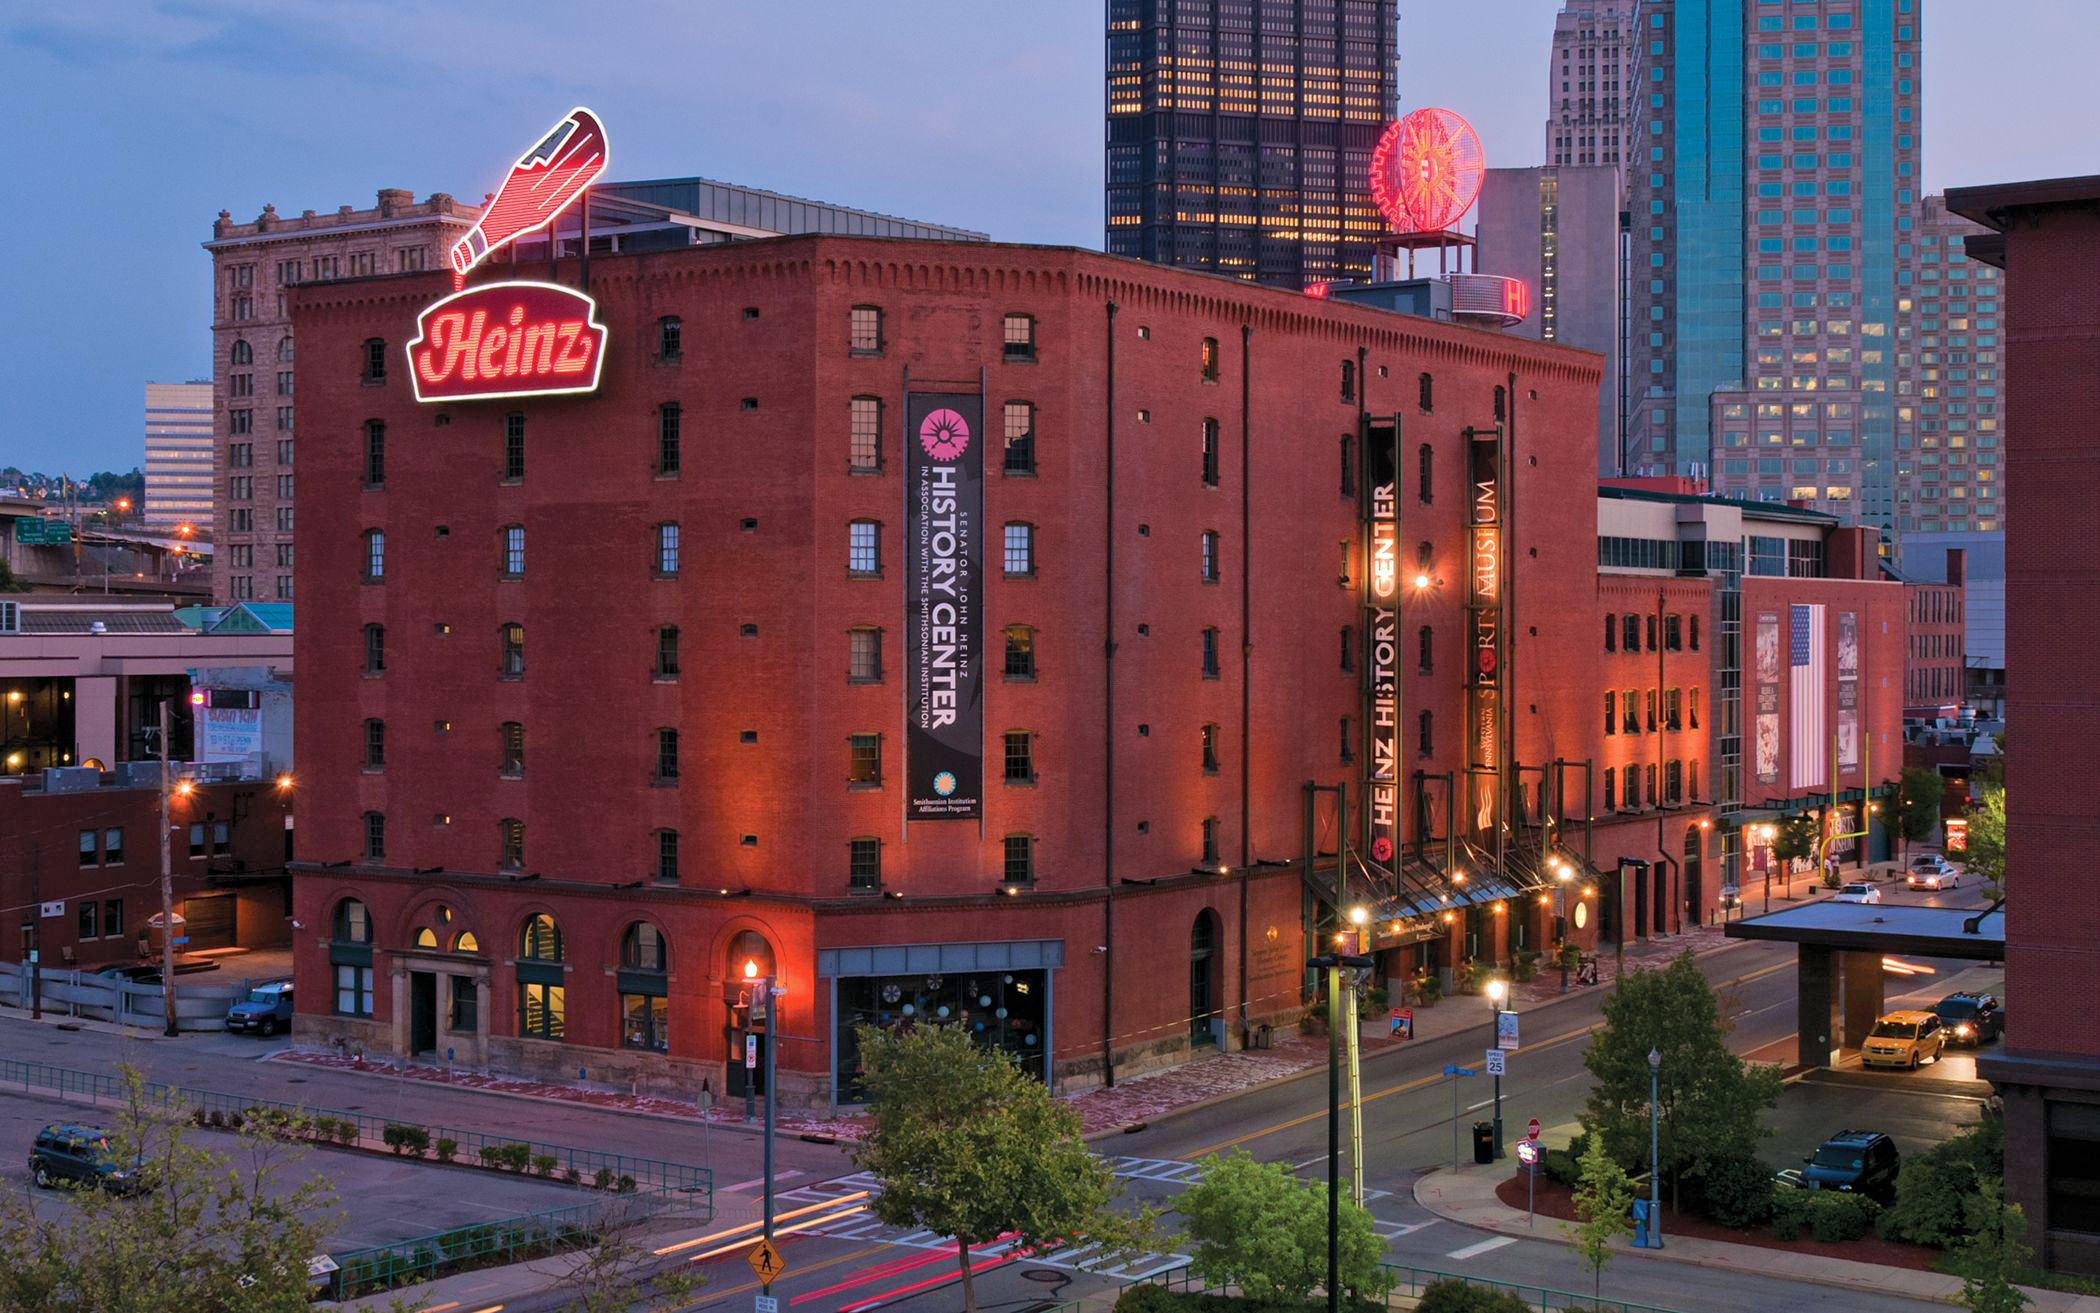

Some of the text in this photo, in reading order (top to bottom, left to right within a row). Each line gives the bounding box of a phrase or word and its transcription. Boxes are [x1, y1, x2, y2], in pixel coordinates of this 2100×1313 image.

[420, 307, 594, 384] Heinz
[920, 466, 929, 729] IN ASSOCIATION WITH THE SMITHSONIAN INSTITUTION
[960, 512, 968, 678] SENATOR JOHN HEINZ
[1374, 481, 1395, 598] CENTER
[1476, 478, 1496, 597] MUSEUM
[932, 467, 956, 730] HISTORY CENTER
[1375, 606, 1396, 727] HISTORY
[1489, 1062, 1503, 1072] 25
